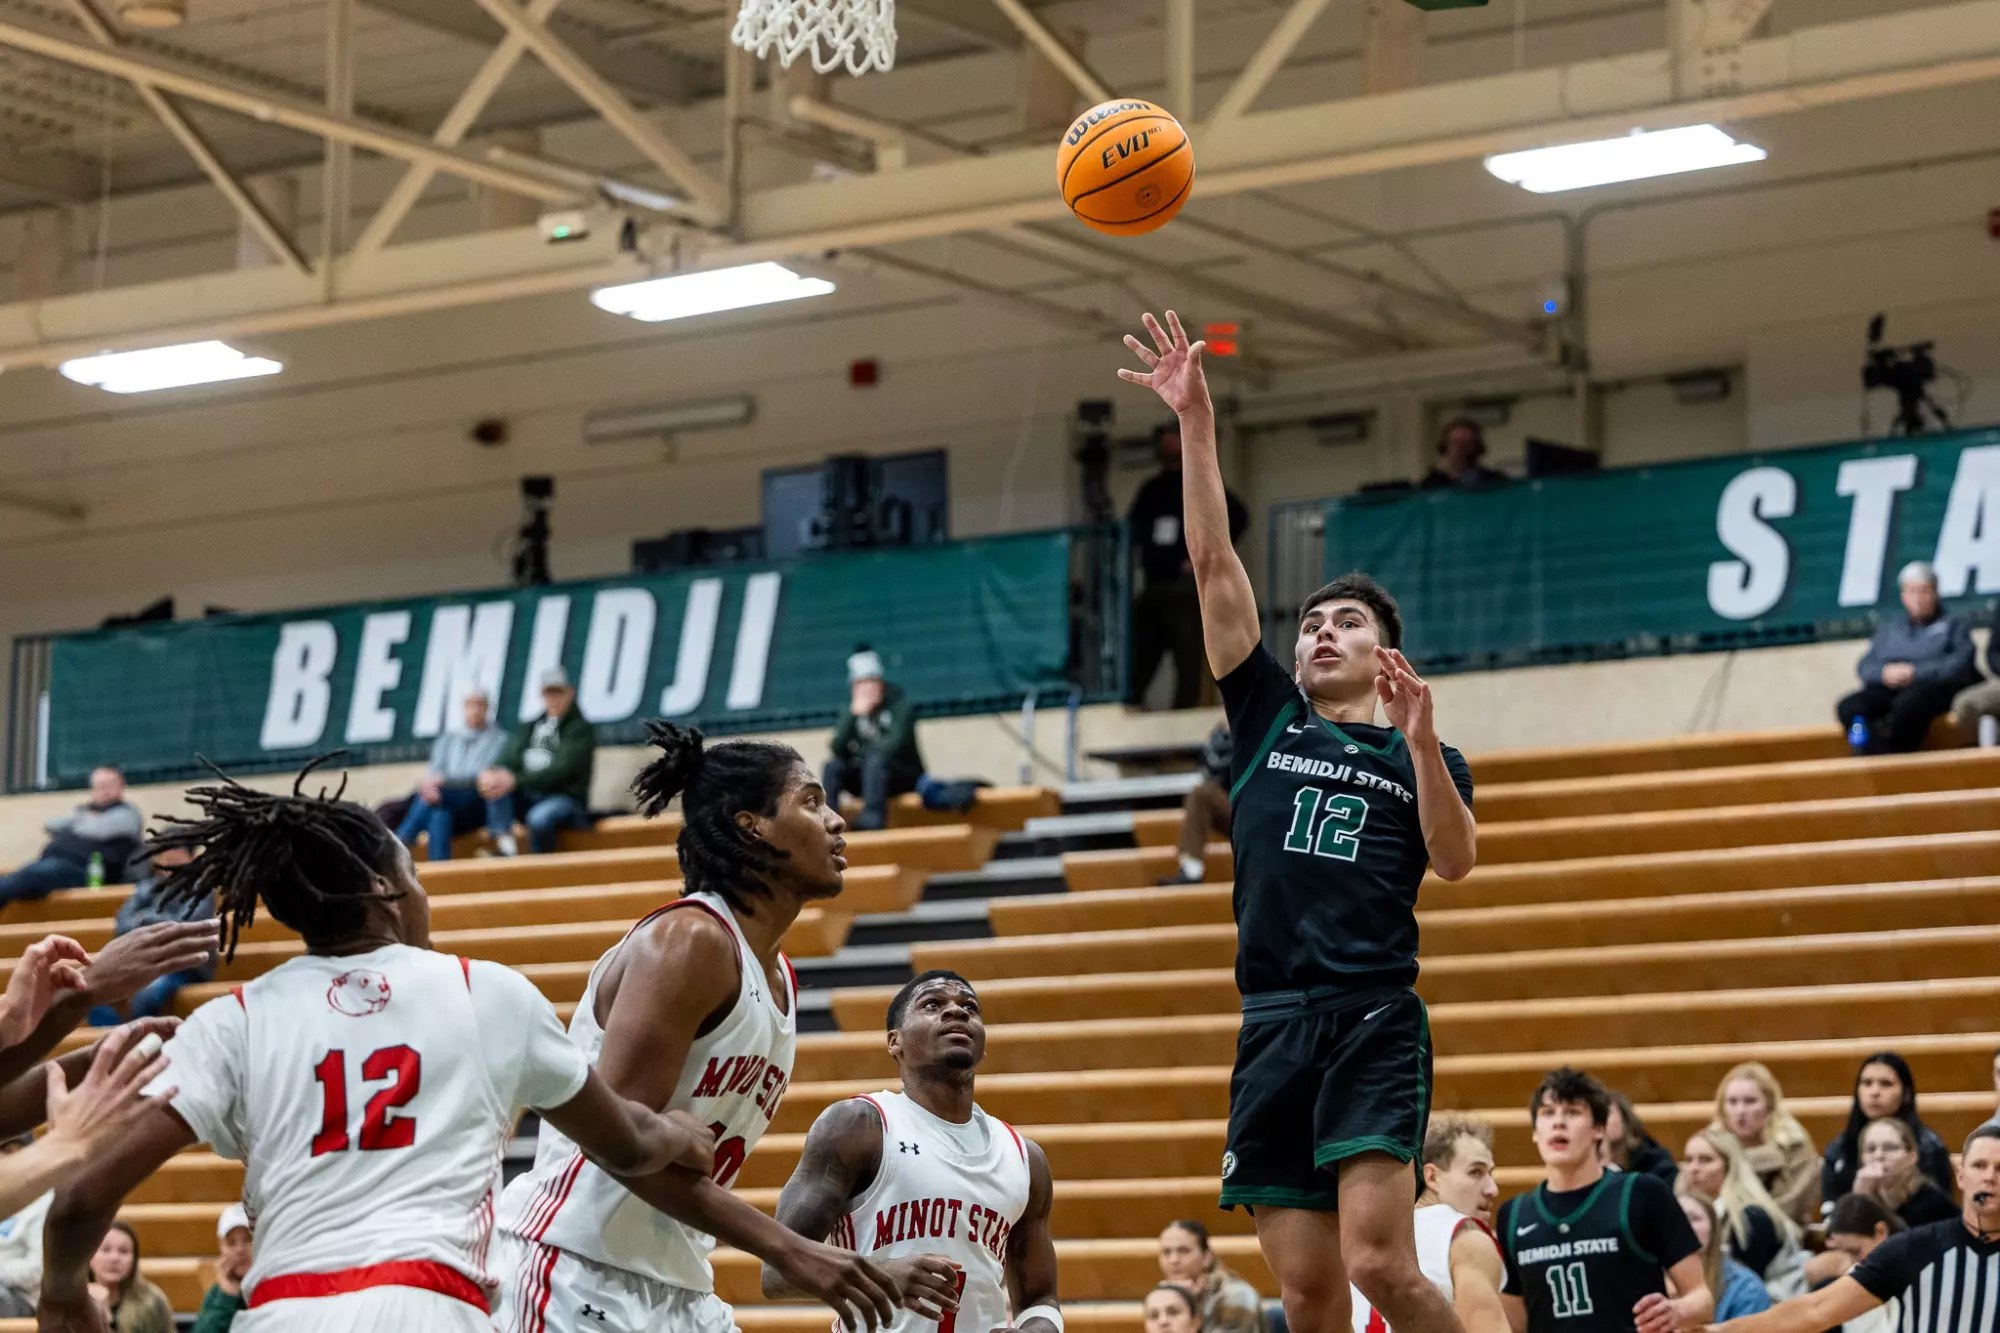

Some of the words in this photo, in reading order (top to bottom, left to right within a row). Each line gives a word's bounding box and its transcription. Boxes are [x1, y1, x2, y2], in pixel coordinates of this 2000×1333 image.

[1101, 131, 1150, 169] EVO
[259, 571, 782, 750] BEMIDJI
[1267, 751, 1352, 783] BEMIDJI
[1353, 770, 1414, 804] STATE
[1283, 785, 1370, 863] 12
[311, 1043, 422, 1158] 12
[872, 1197, 963, 1252] MINOT
[1517, 1241, 1572, 1266] BEMIDJI
[1572, 1236, 1619, 1256] STATE
[1545, 1260, 1594, 1318] 11
